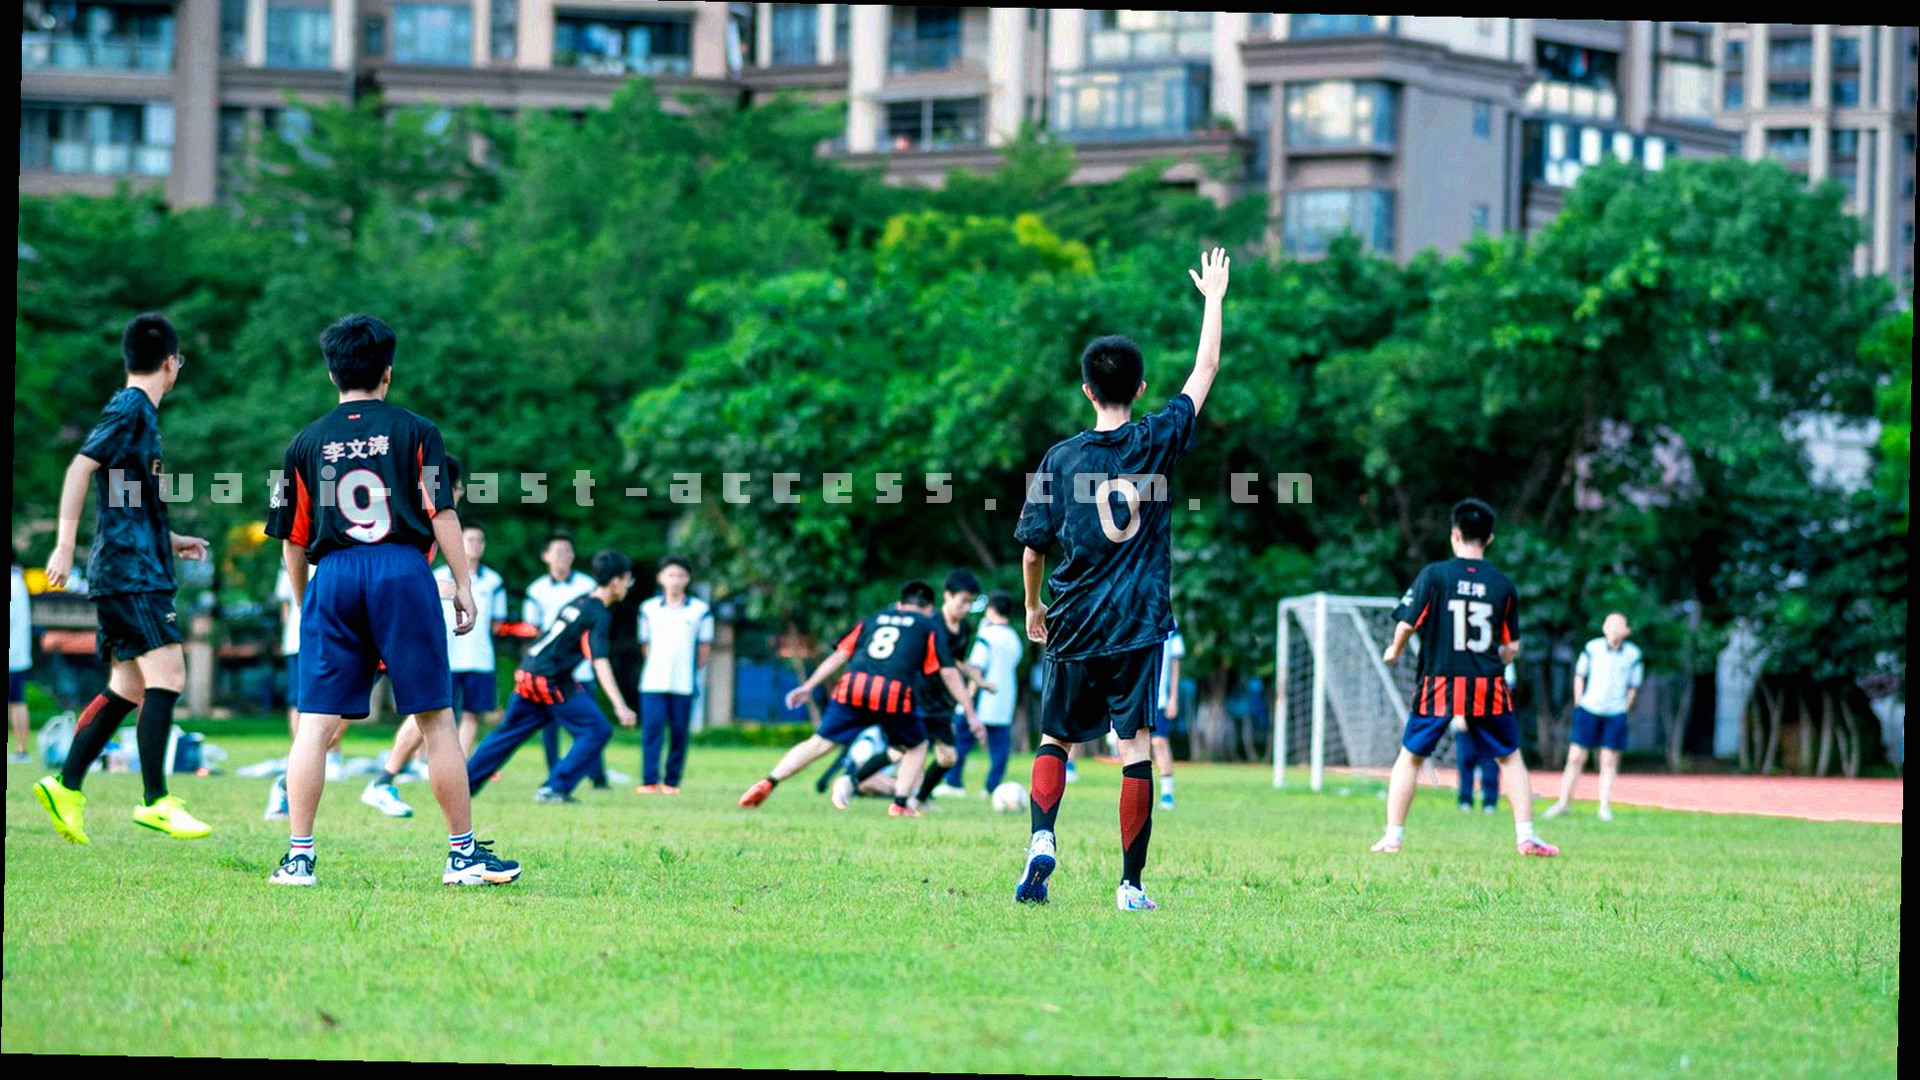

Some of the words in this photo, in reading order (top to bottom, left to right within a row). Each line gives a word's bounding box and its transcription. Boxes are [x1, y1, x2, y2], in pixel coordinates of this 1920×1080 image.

[322, 435, 390, 463] 李文涛
[336, 468, 391, 543] 9
[1096, 478, 1141, 544] 0
[867, 625, 900, 659] 8
[1447, 599, 1493, 654] 13
